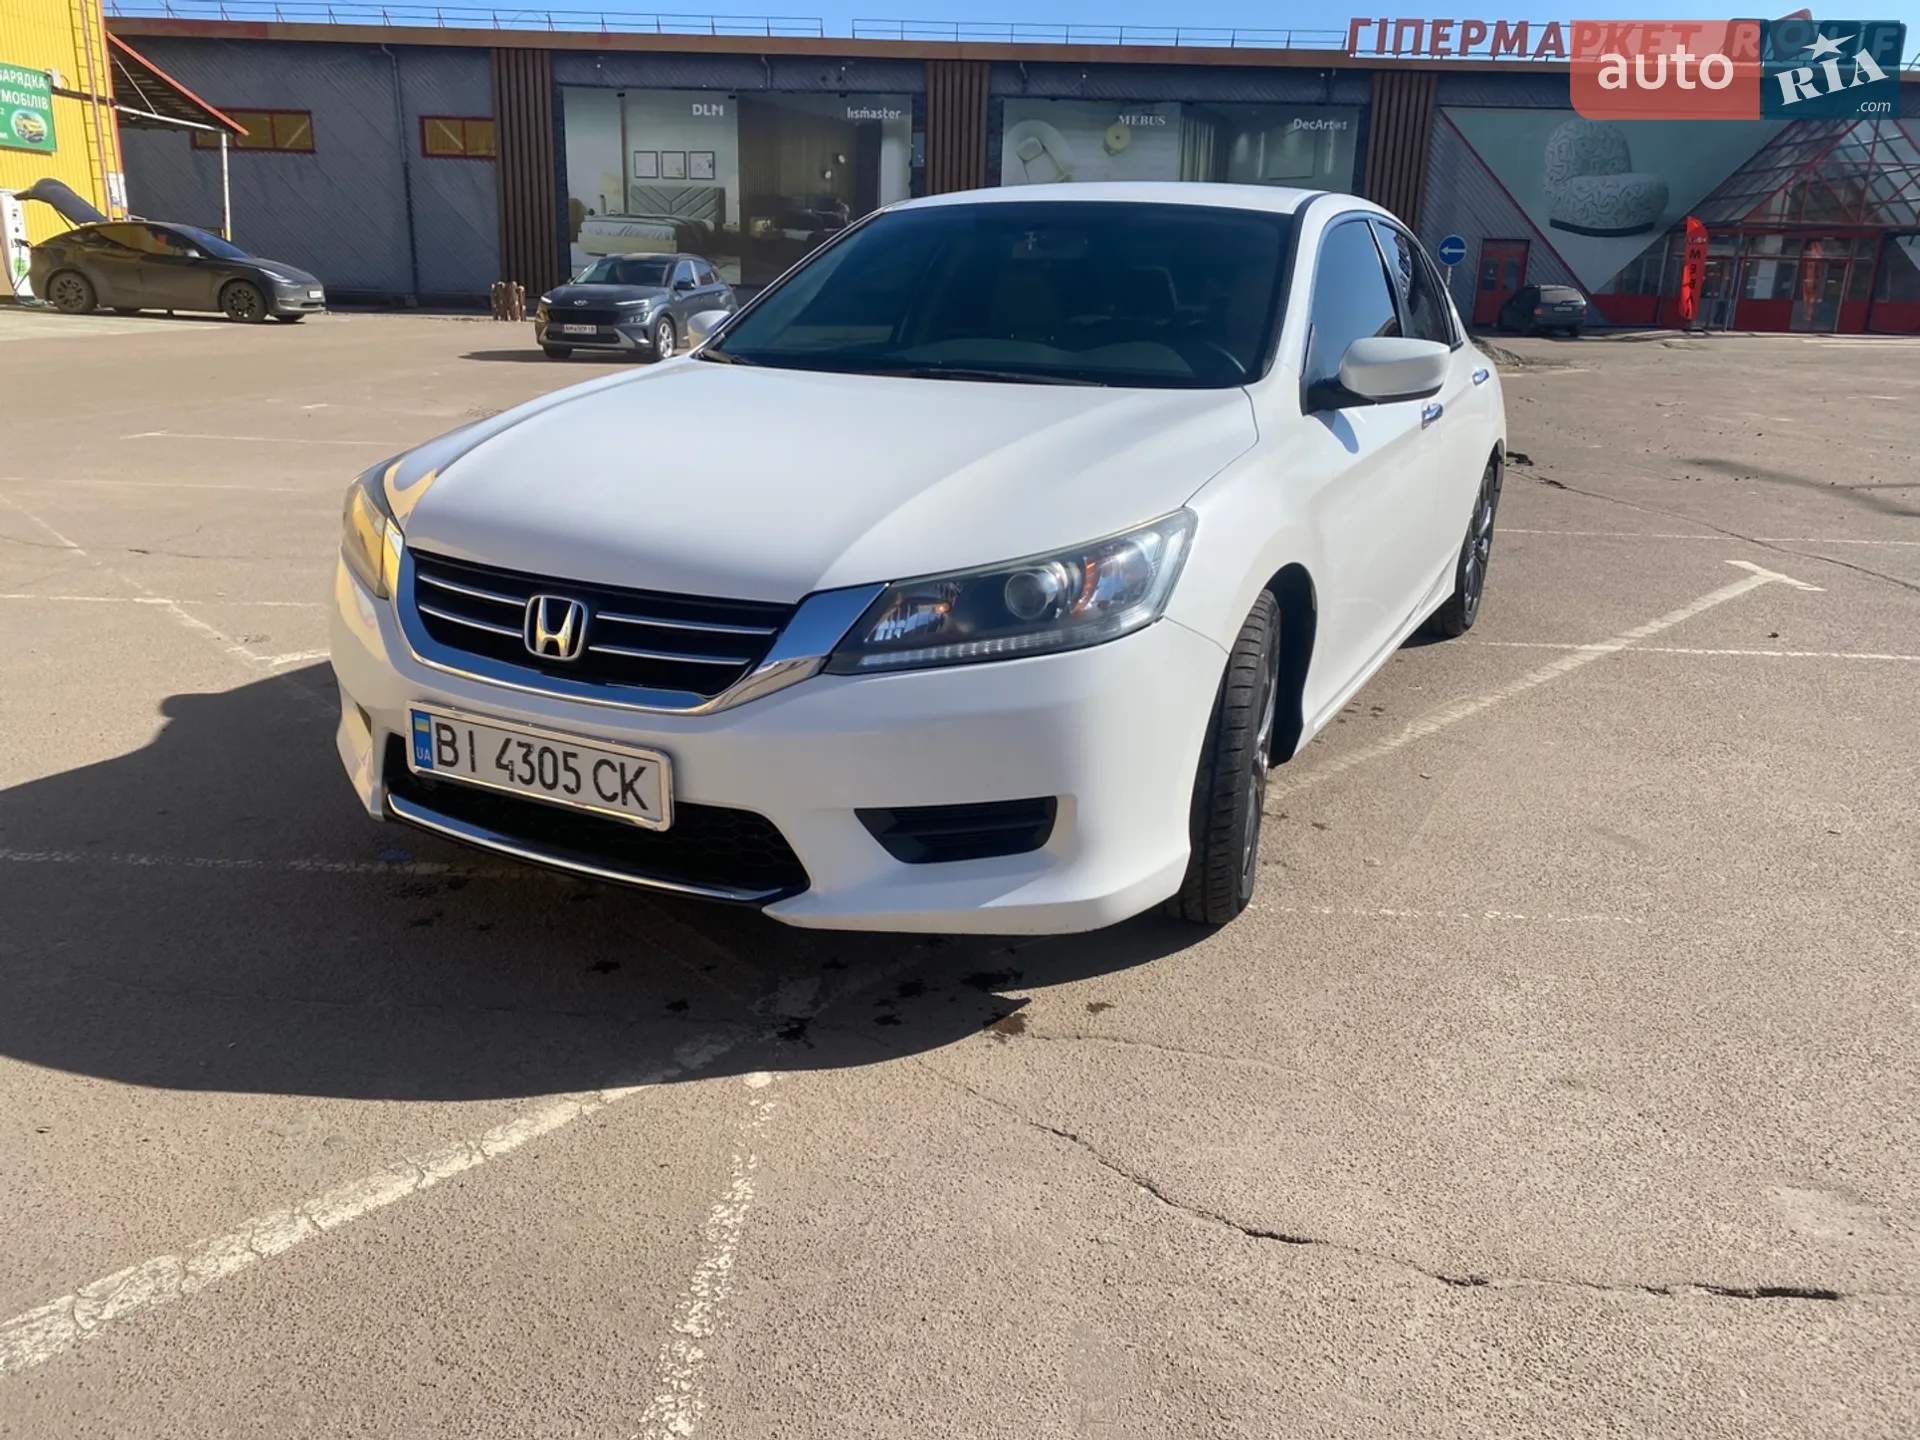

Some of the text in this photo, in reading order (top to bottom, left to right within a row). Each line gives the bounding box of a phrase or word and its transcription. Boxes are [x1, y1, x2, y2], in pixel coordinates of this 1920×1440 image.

[1348, 18, 1703, 60] ГІПЕРМАРКЕТ
[0, 88, 49, 111] МОБІЛІВ
[1118, 114, 1166, 126] MEBUS
[415, 748, 432, 762] UA
[435, 722, 648, 810] BI 4305 CK
